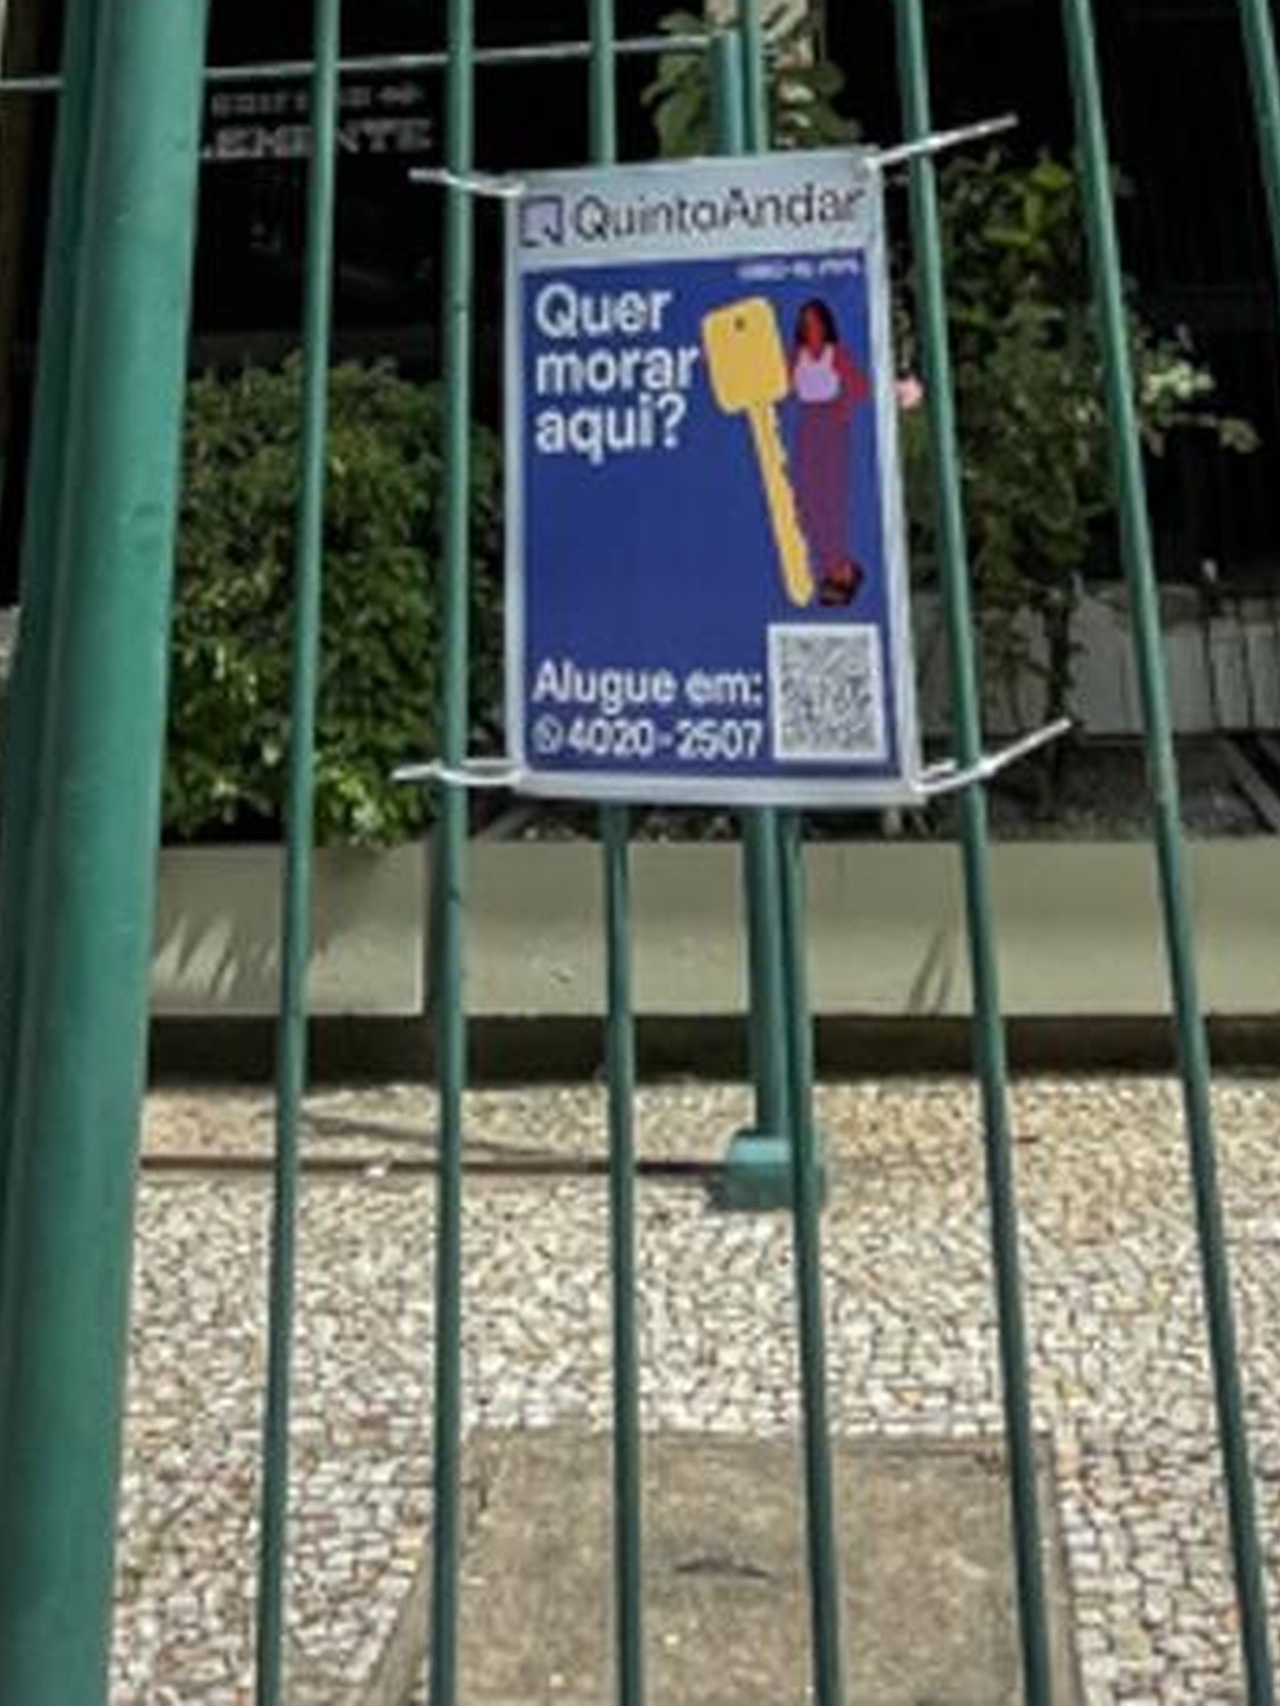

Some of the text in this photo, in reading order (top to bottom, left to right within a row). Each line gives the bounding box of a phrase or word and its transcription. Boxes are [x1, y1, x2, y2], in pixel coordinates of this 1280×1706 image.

[575, 183, 864, 239] QuintoAndar
[535, 283, 673, 338] Quer
[535, 345, 700, 395] morar
[535, 392, 687, 465] aqui?
[531, 658, 763, 713] Alugue em:
